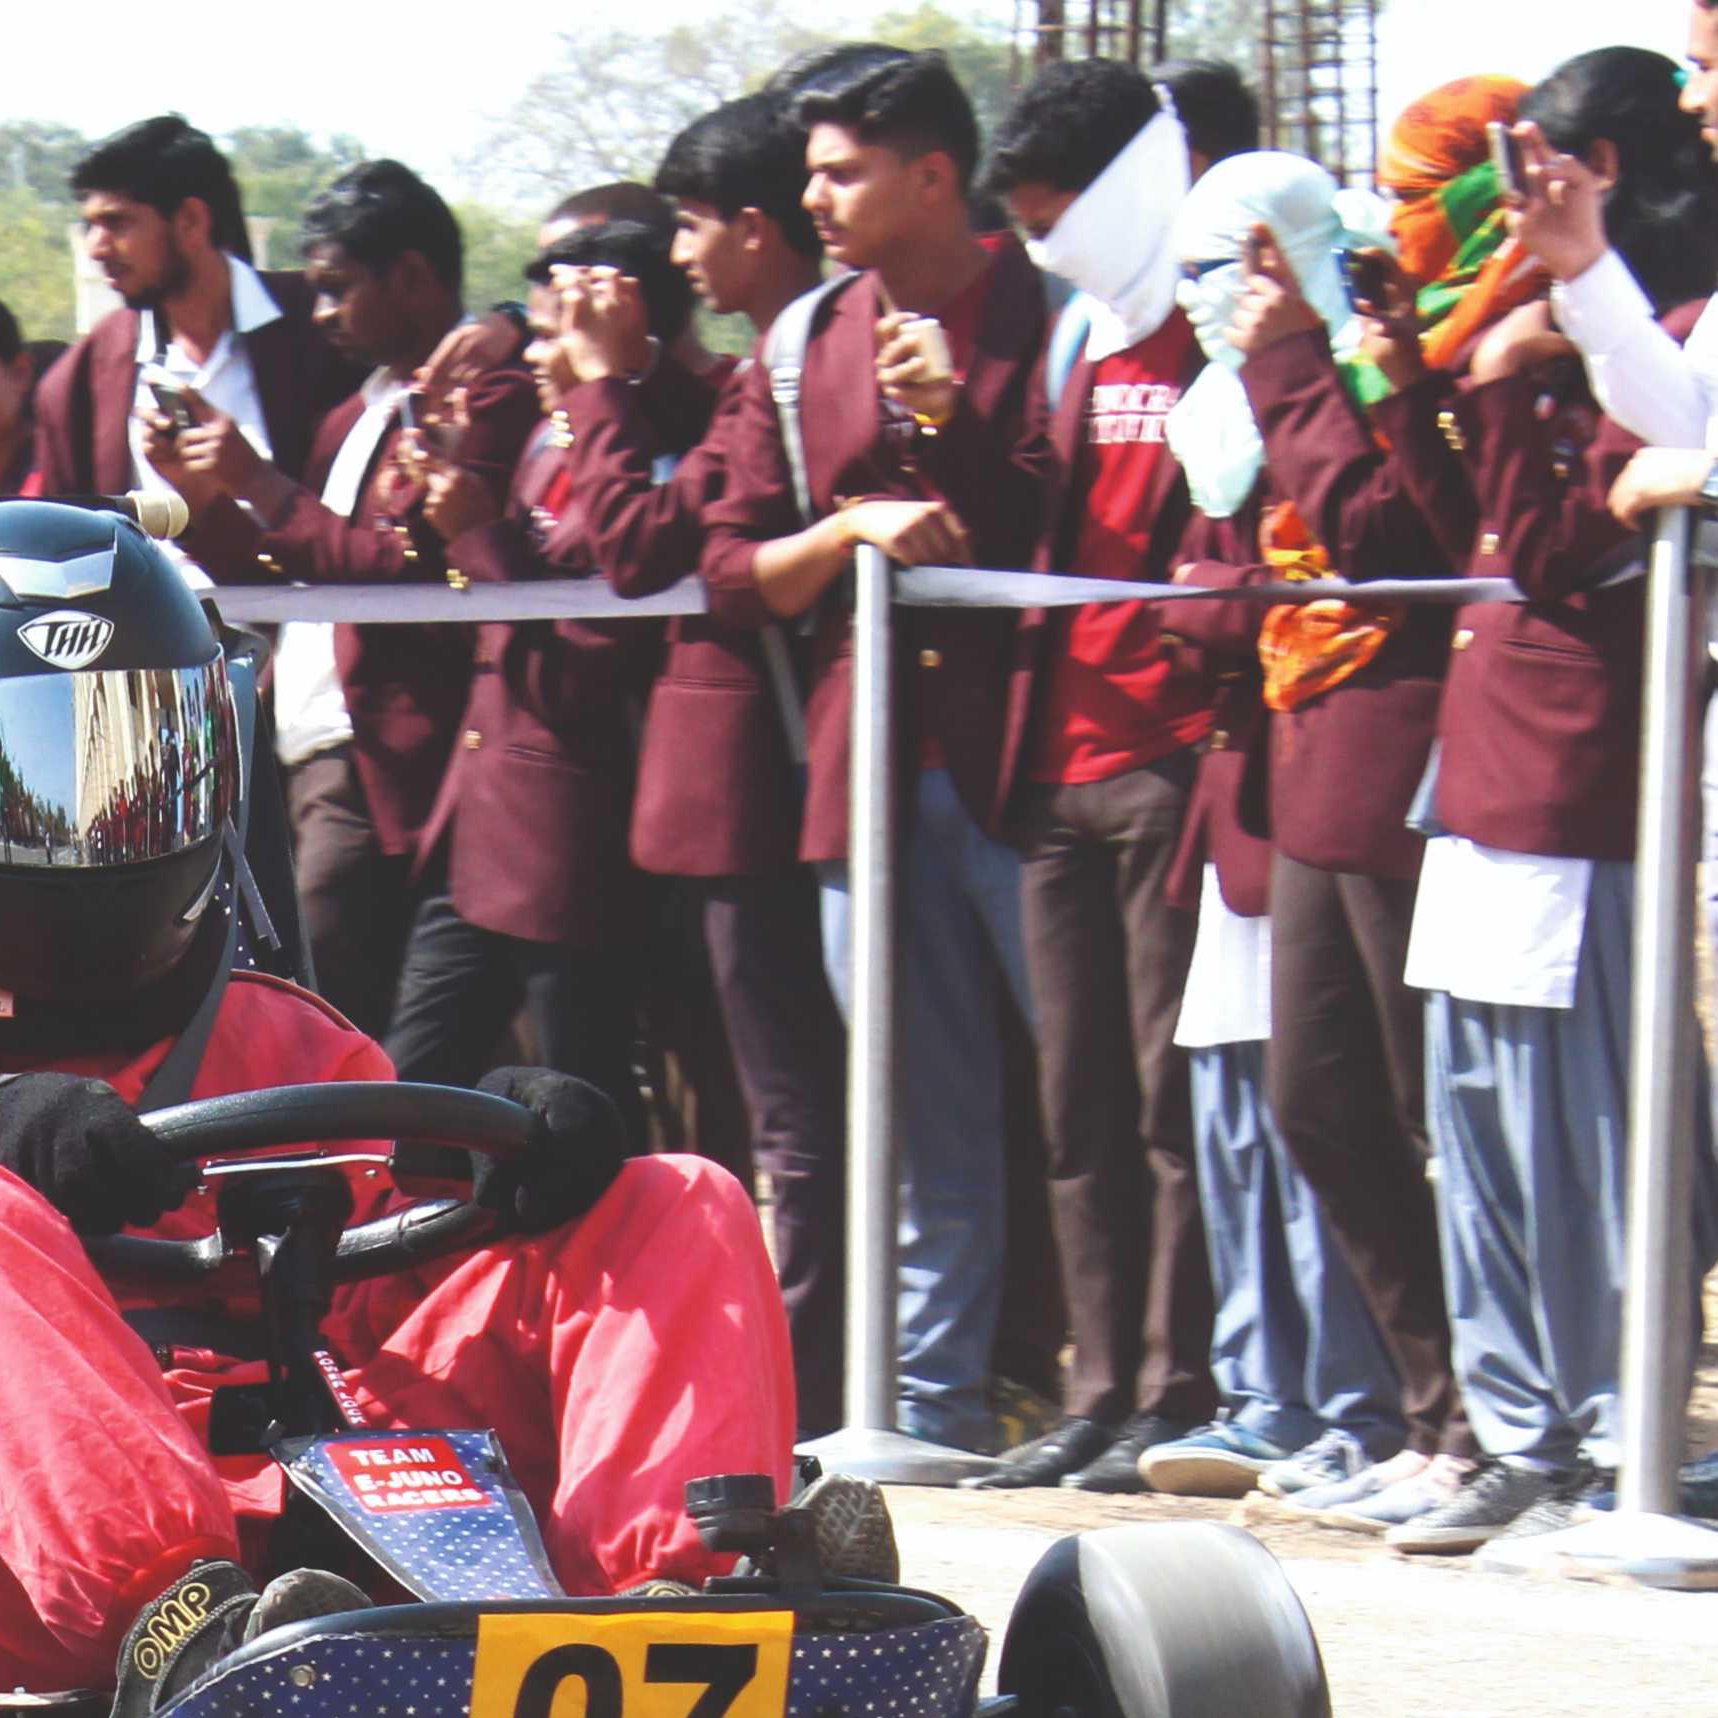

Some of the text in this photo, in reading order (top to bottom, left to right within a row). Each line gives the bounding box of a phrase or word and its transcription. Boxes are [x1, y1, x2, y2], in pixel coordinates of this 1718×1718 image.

[348, 1448, 436, 1467] TEAM
[354, 1470, 464, 1492] E-JUNO
[359, 1488, 484, 1509] RACERS
[133, 1582, 211, 1680] OMP
